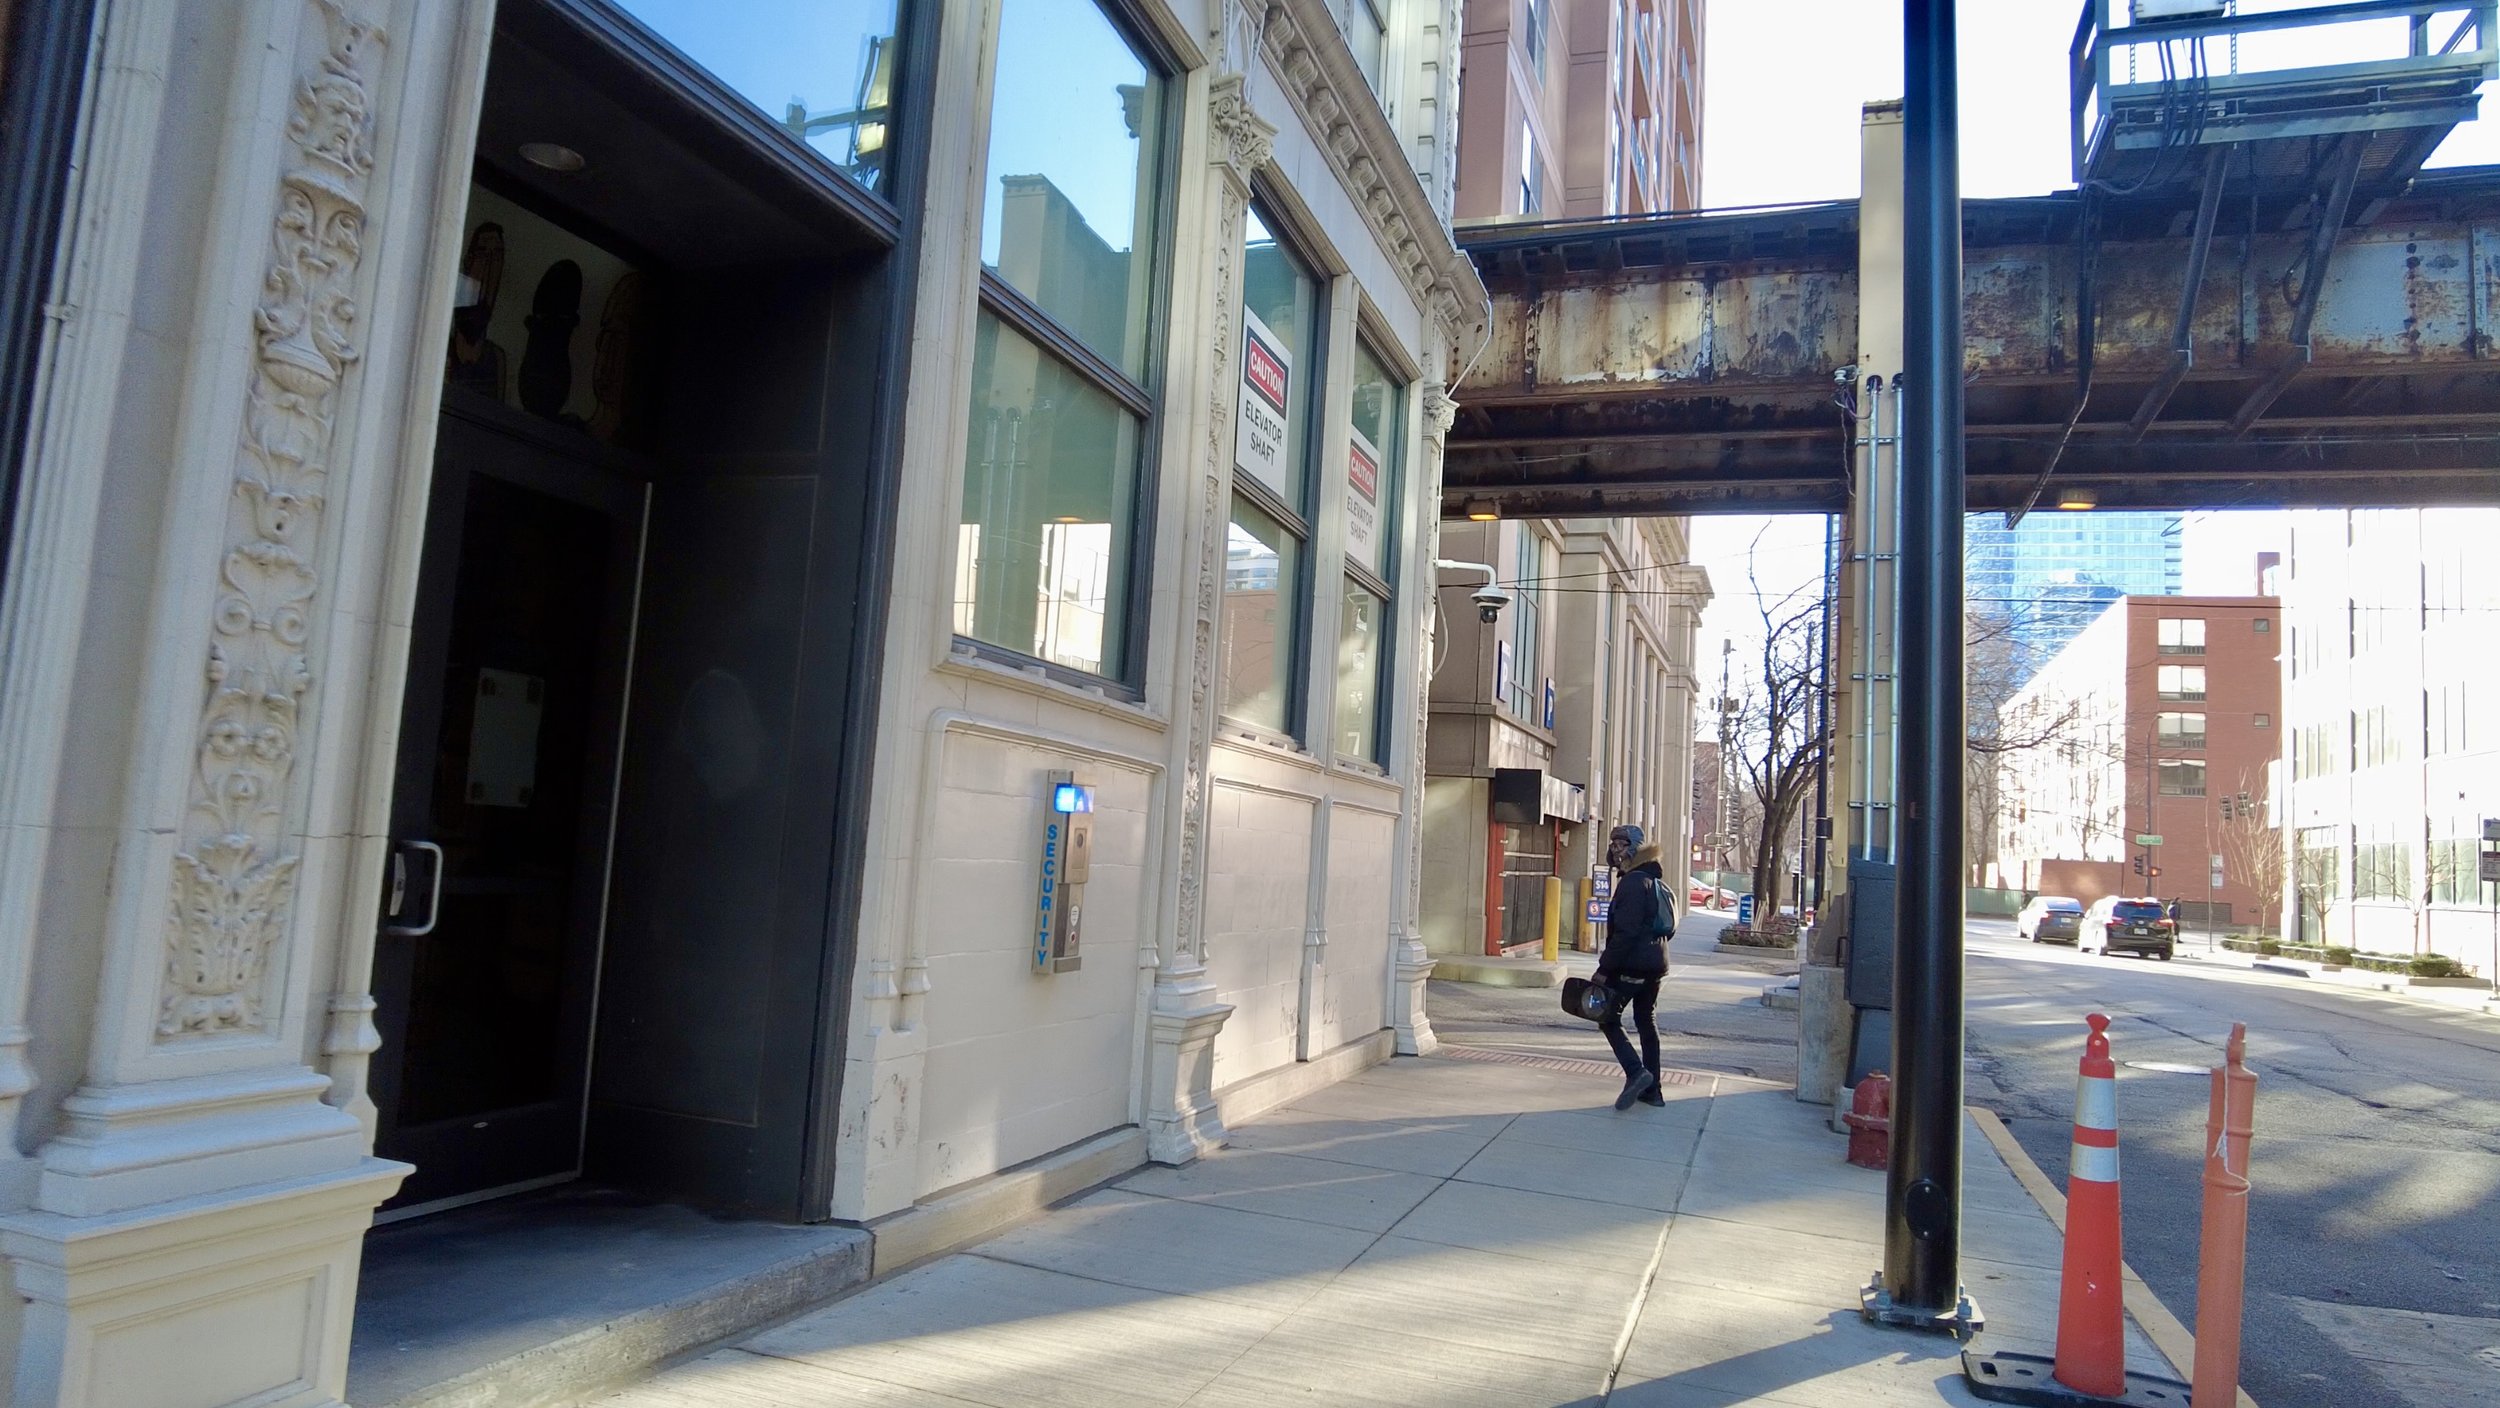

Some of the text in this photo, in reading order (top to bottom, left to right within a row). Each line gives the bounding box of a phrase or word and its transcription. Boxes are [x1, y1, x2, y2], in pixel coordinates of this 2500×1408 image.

[1250, 352, 1284, 399] CAUTION
[1246, 399, 1282, 446] ELEVATOR
[1250, 433, 1276, 466] SHAFT
[1351, 457, 1375, 491] CAUTION
[1347, 499, 1373, 528] ELEVATOR
[1350, 523, 1368, 545] SHAFT
[1548, 695, 1554, 720] P
[1037, 824, 1058, 966] SECURITY
